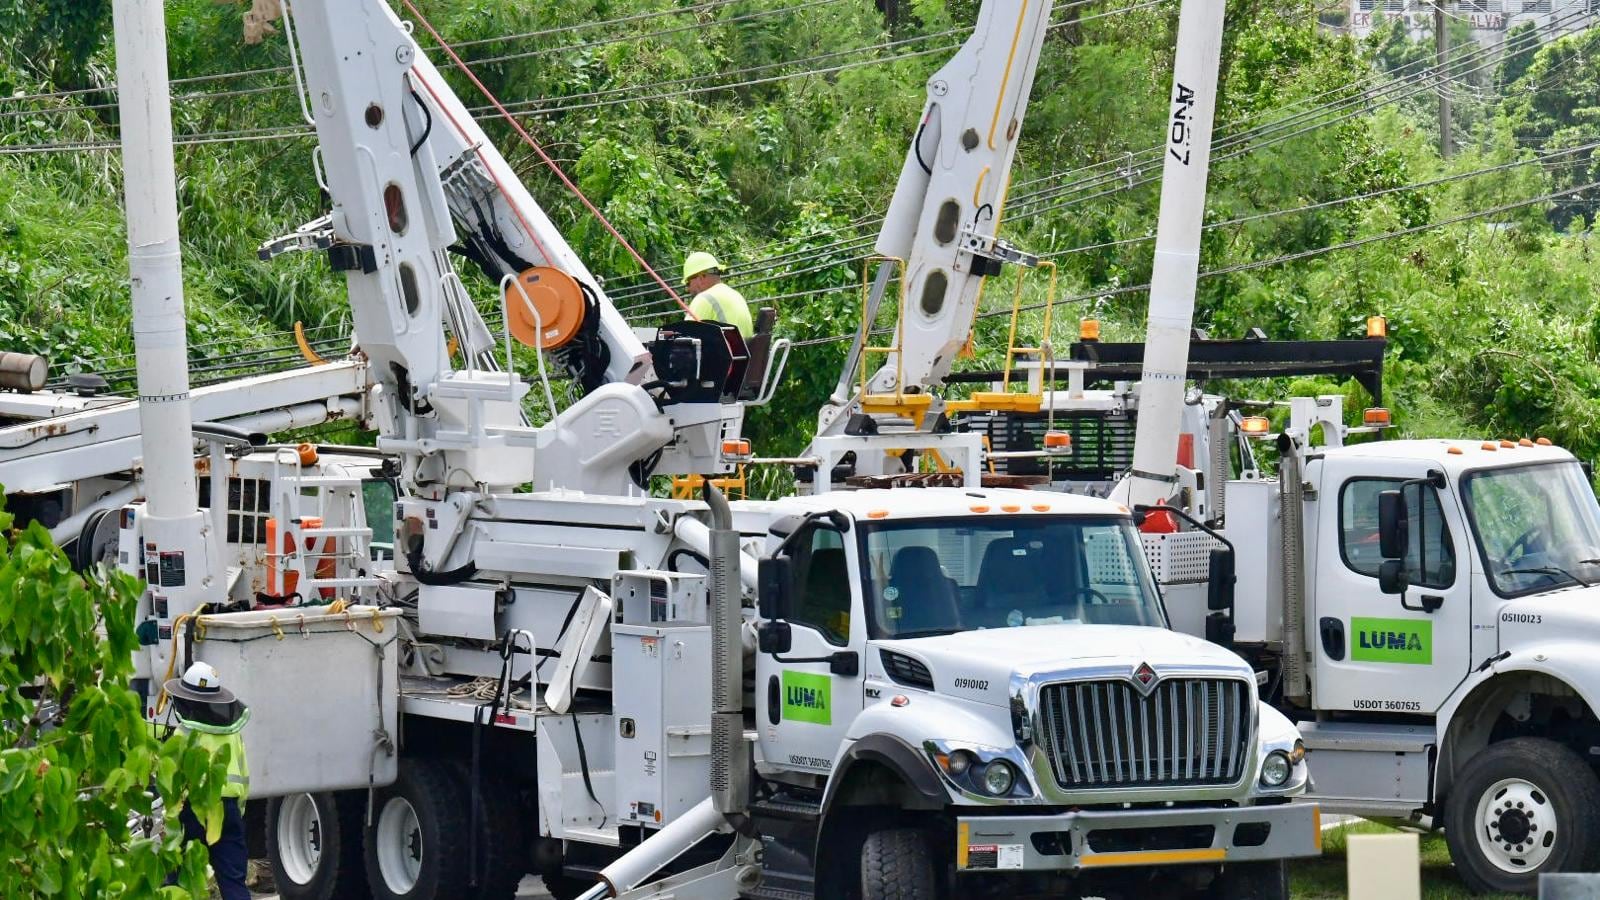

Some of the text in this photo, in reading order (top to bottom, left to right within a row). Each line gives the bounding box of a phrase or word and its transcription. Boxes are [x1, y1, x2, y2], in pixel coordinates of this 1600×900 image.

[1502, 613, 1542, 624] 05110123
[1360, 631, 1422, 650] LUMA
[954, 678, 989, 690] 01910102
[787, 686, 825, 709] LUMA
[1353, 699, 1421, 710] USDOT 3607625
